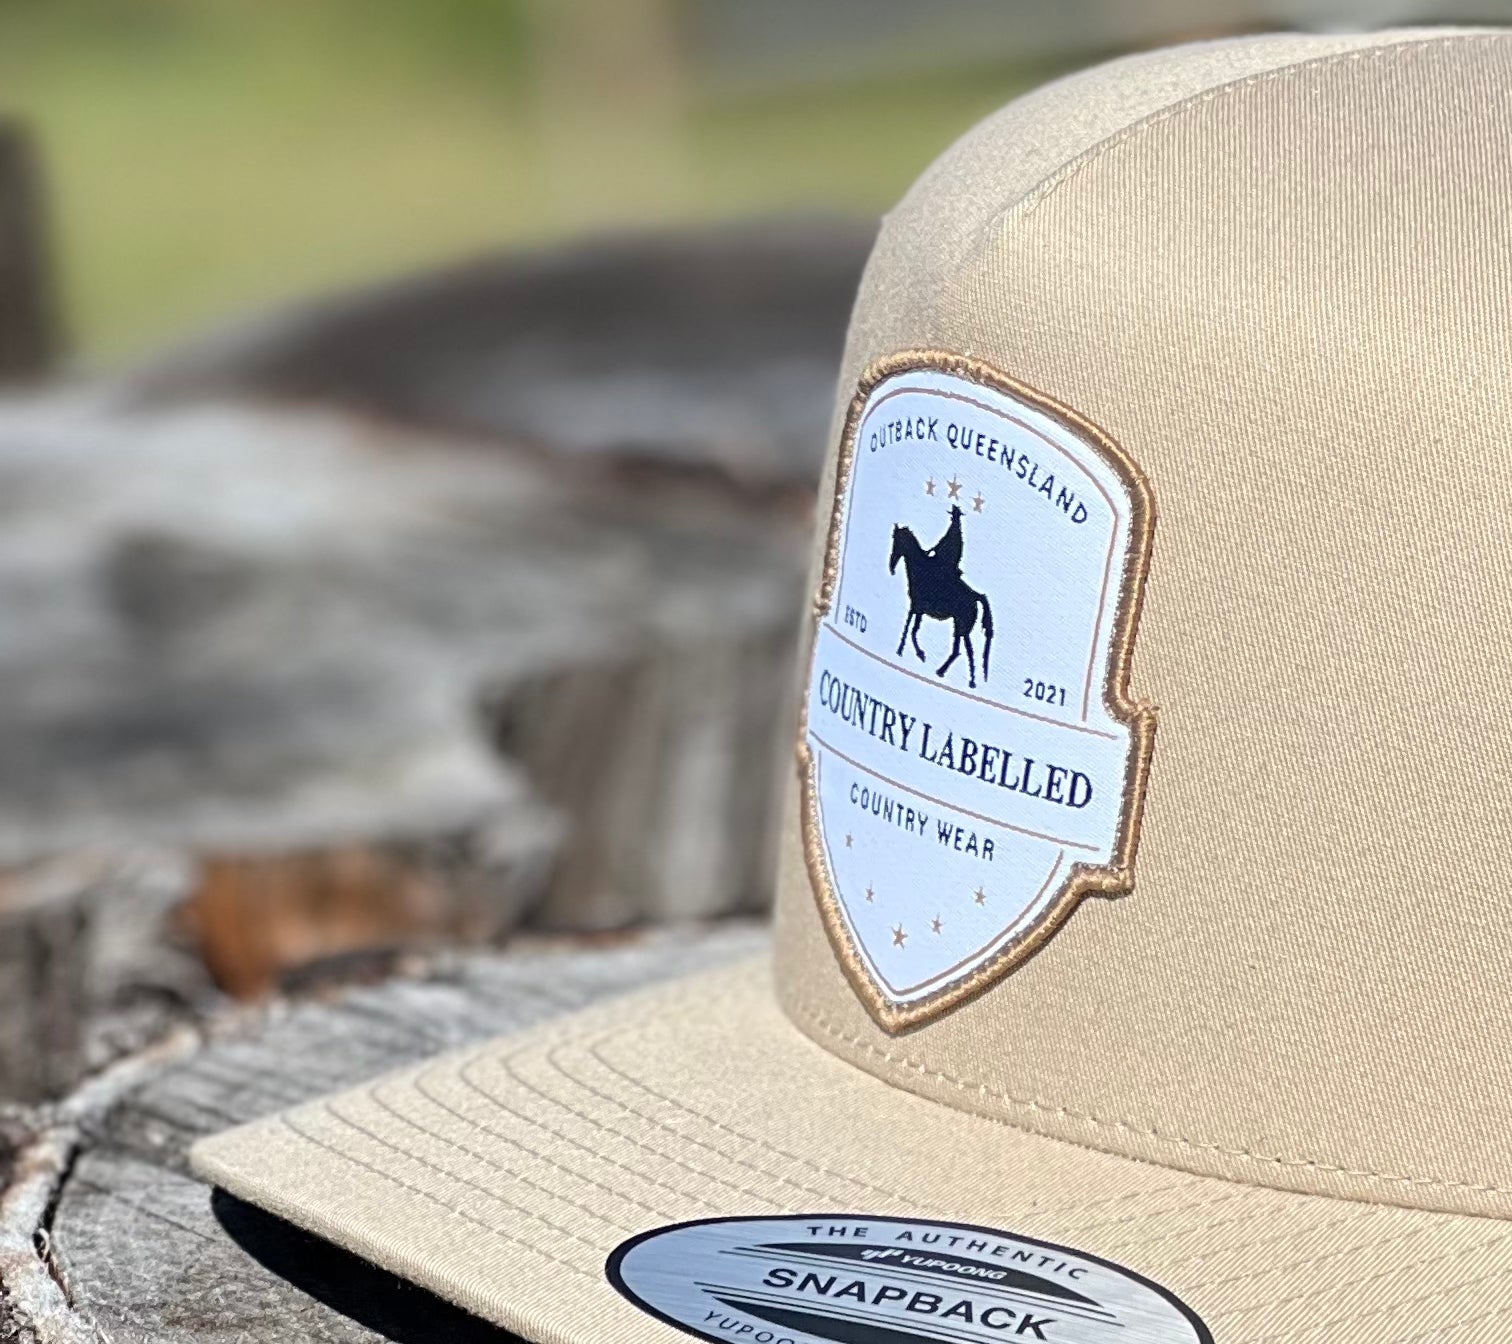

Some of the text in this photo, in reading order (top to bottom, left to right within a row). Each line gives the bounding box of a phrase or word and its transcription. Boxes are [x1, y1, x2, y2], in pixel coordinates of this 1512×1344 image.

[870, 416, 1089, 525] OUTBACK QUEENSLAND
[1023, 678, 1067, 707] 2021
[819, 669, 1093, 809] COUNTRY LABELLED
[849, 782, 996, 861] COUNTRY WEAR
[806, 1225, 1090, 1281] THE AUTHENTIC
[900, 1253, 1009, 1281] YUPOONG
[762, 1266, 1059, 1341] SNAPBACK
